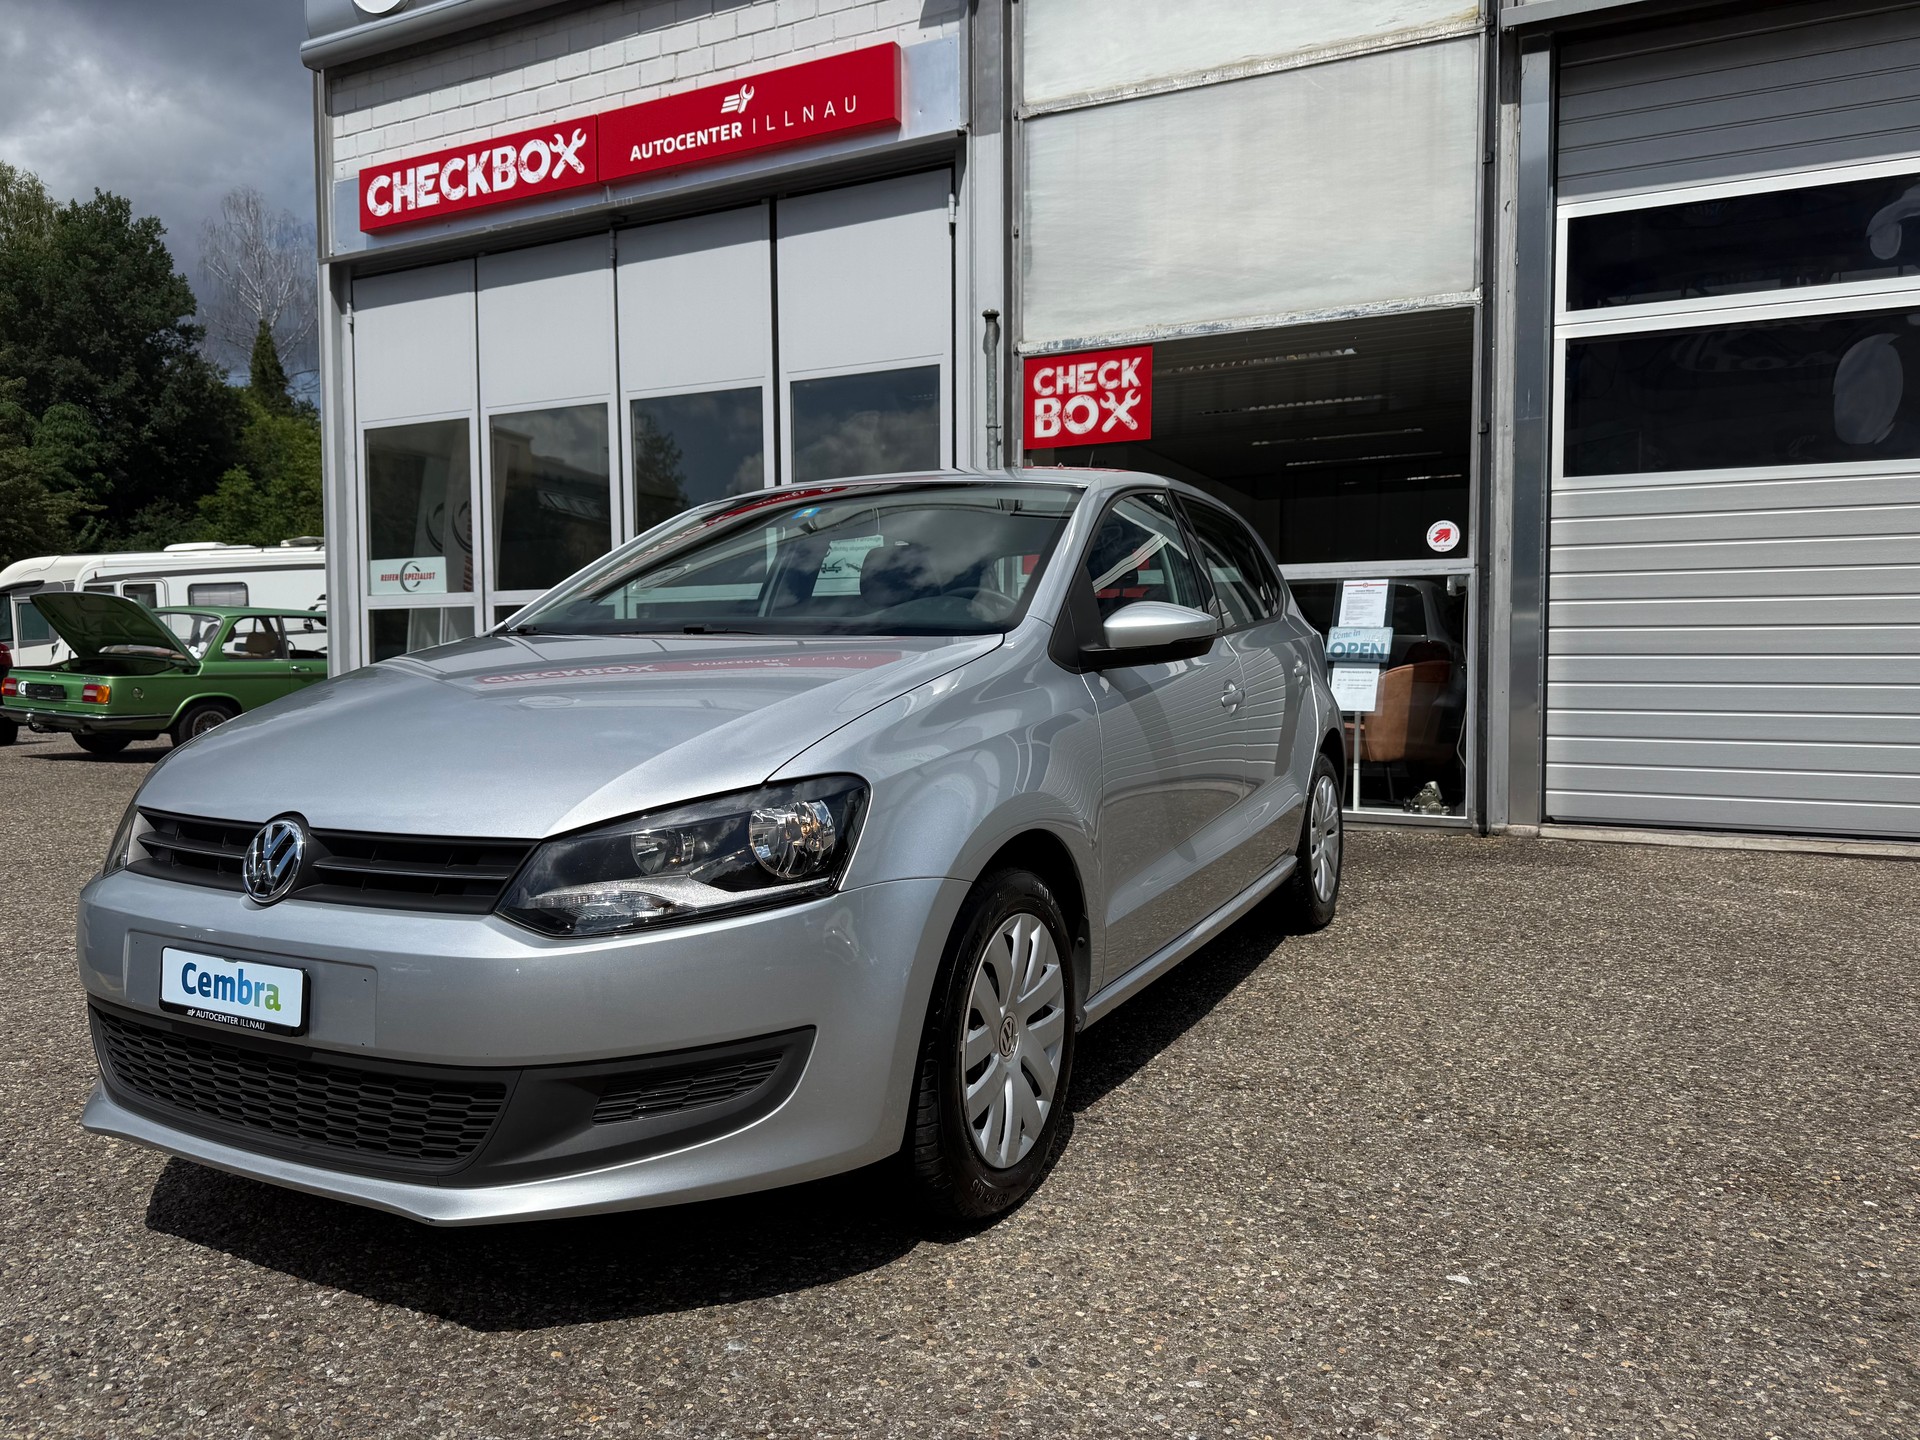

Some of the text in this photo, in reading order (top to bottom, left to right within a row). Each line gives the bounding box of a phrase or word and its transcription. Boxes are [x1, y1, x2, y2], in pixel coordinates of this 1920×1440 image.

[630, 95, 858, 162] AUTOCENTER ILLNAU
[367, 128, 587, 217] CHECKBOX
[1033, 356, 1143, 396] CHECK
[1034, 388, 1142, 439] BOX
[380, 572, 436, 582] REIFEN SPEZIALIST
[1330, 642, 1386, 659] OPEN
[181, 962, 282, 1012] Cembra
[195, 1010, 266, 1031] AUTOCENTER ILLNAU
